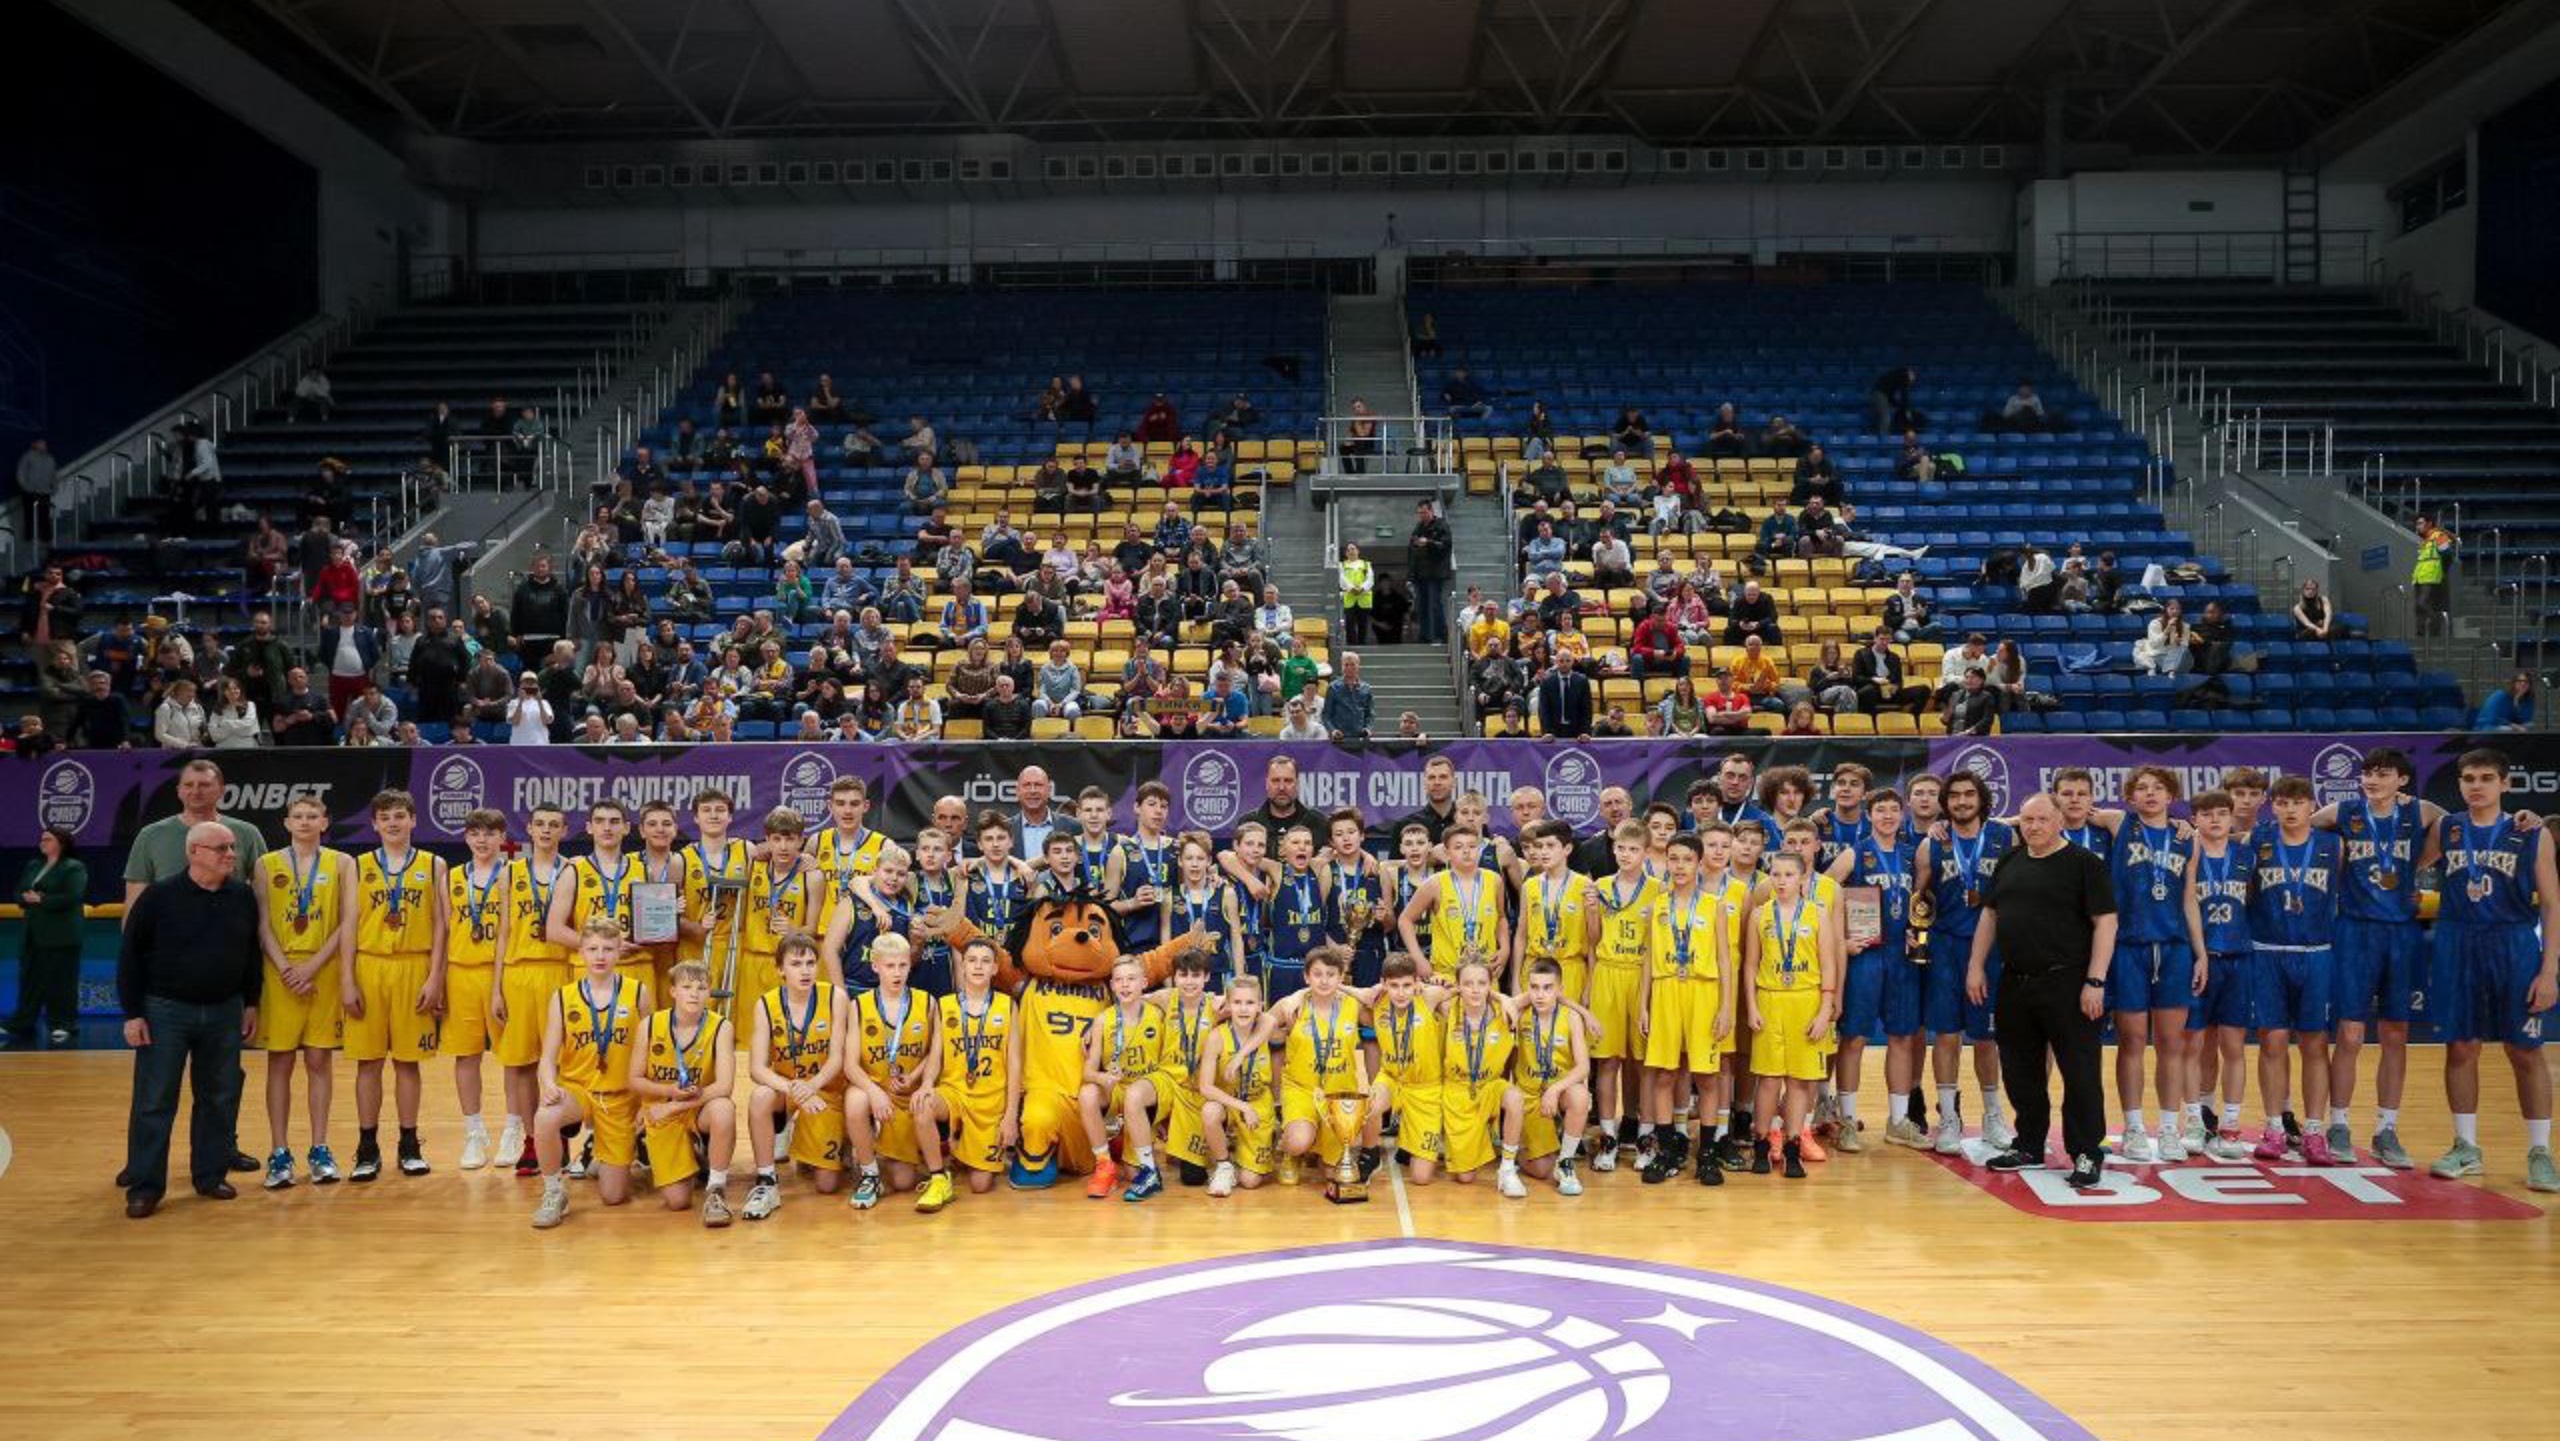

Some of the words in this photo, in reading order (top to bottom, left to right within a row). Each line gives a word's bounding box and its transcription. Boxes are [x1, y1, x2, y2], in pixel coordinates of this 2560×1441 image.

[963, 773, 1072, 802] JÖGL
[1299, 771, 1360, 807] NBET
[1368, 771, 1512, 807] СУПЛГА
[2039, 767, 2133, 802] FBET
[2509, 765, 2560, 793] ÖG
[216, 783, 332, 810] ONBET
[513, 776, 604, 812] FONBET
[1194, 797, 1229, 815] СУПЕР
[1557, 795, 1591, 813] СУПЕР
[1942, 858, 1998, 883] ХИКИ
[370, 887, 423, 909] ХИКИ
[2208, 903, 2231, 923] 23
[1619, 919, 1636, 940] 15
[1046, 1011, 1094, 1039] 97
[572, 1028, 629, 1050] ХИКИ
[868, 1041, 923, 1064] ХИКИ
[2019, 1167, 2404, 1205] BET
